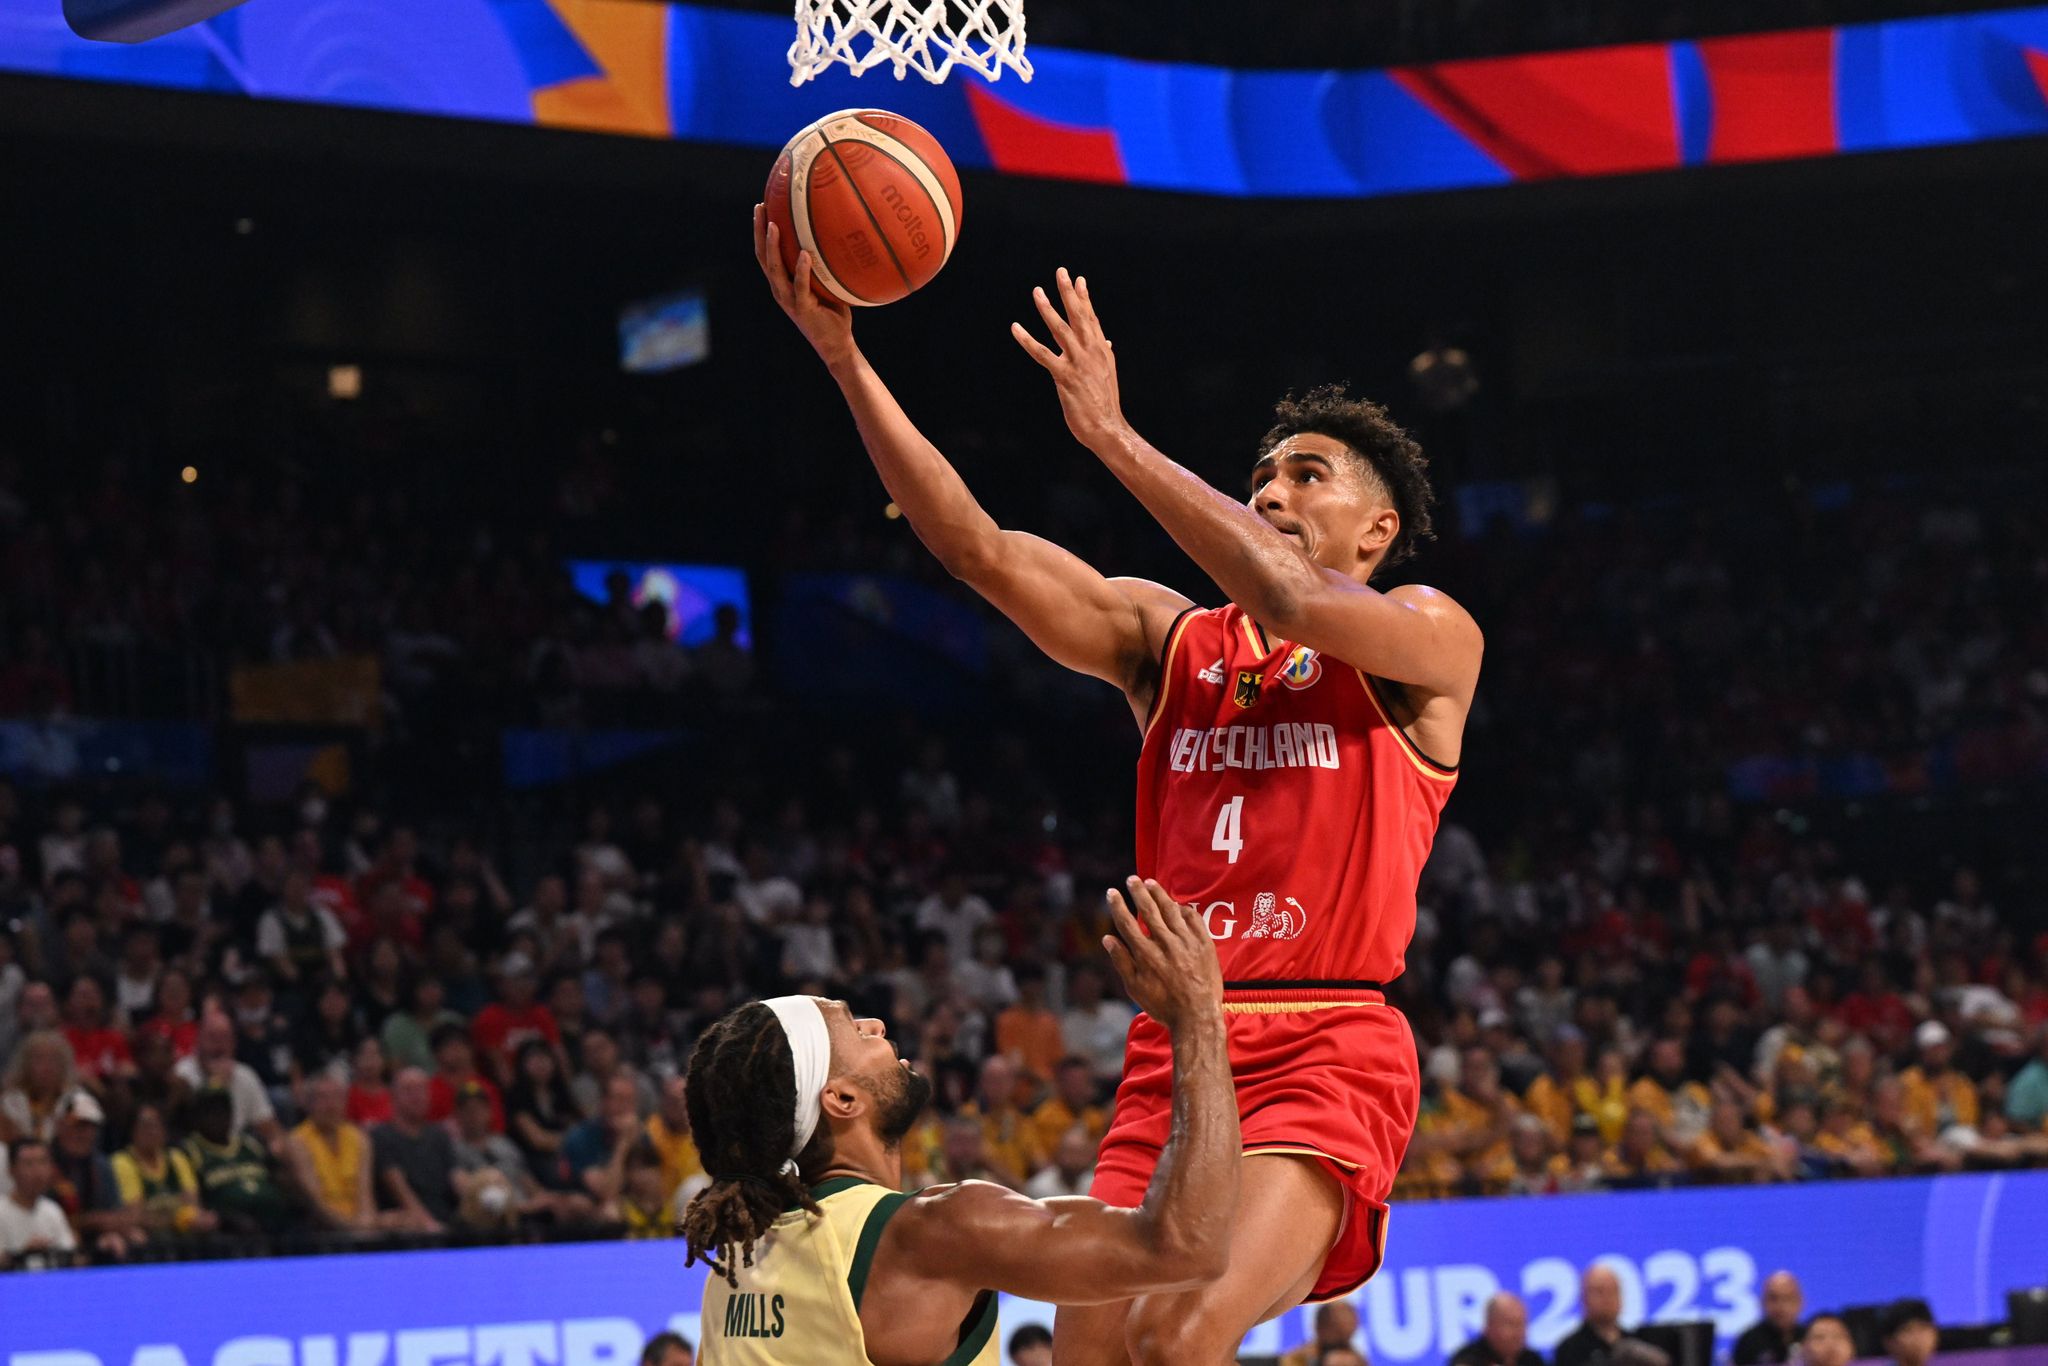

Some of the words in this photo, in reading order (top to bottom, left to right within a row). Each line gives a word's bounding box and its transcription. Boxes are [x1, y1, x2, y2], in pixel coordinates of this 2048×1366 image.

[880, 184, 931, 260] molten
[1197, 668, 1224, 686] PEA
[1212, 796, 1244, 864] 4
[724, 1294, 784, 1338] MILLS
